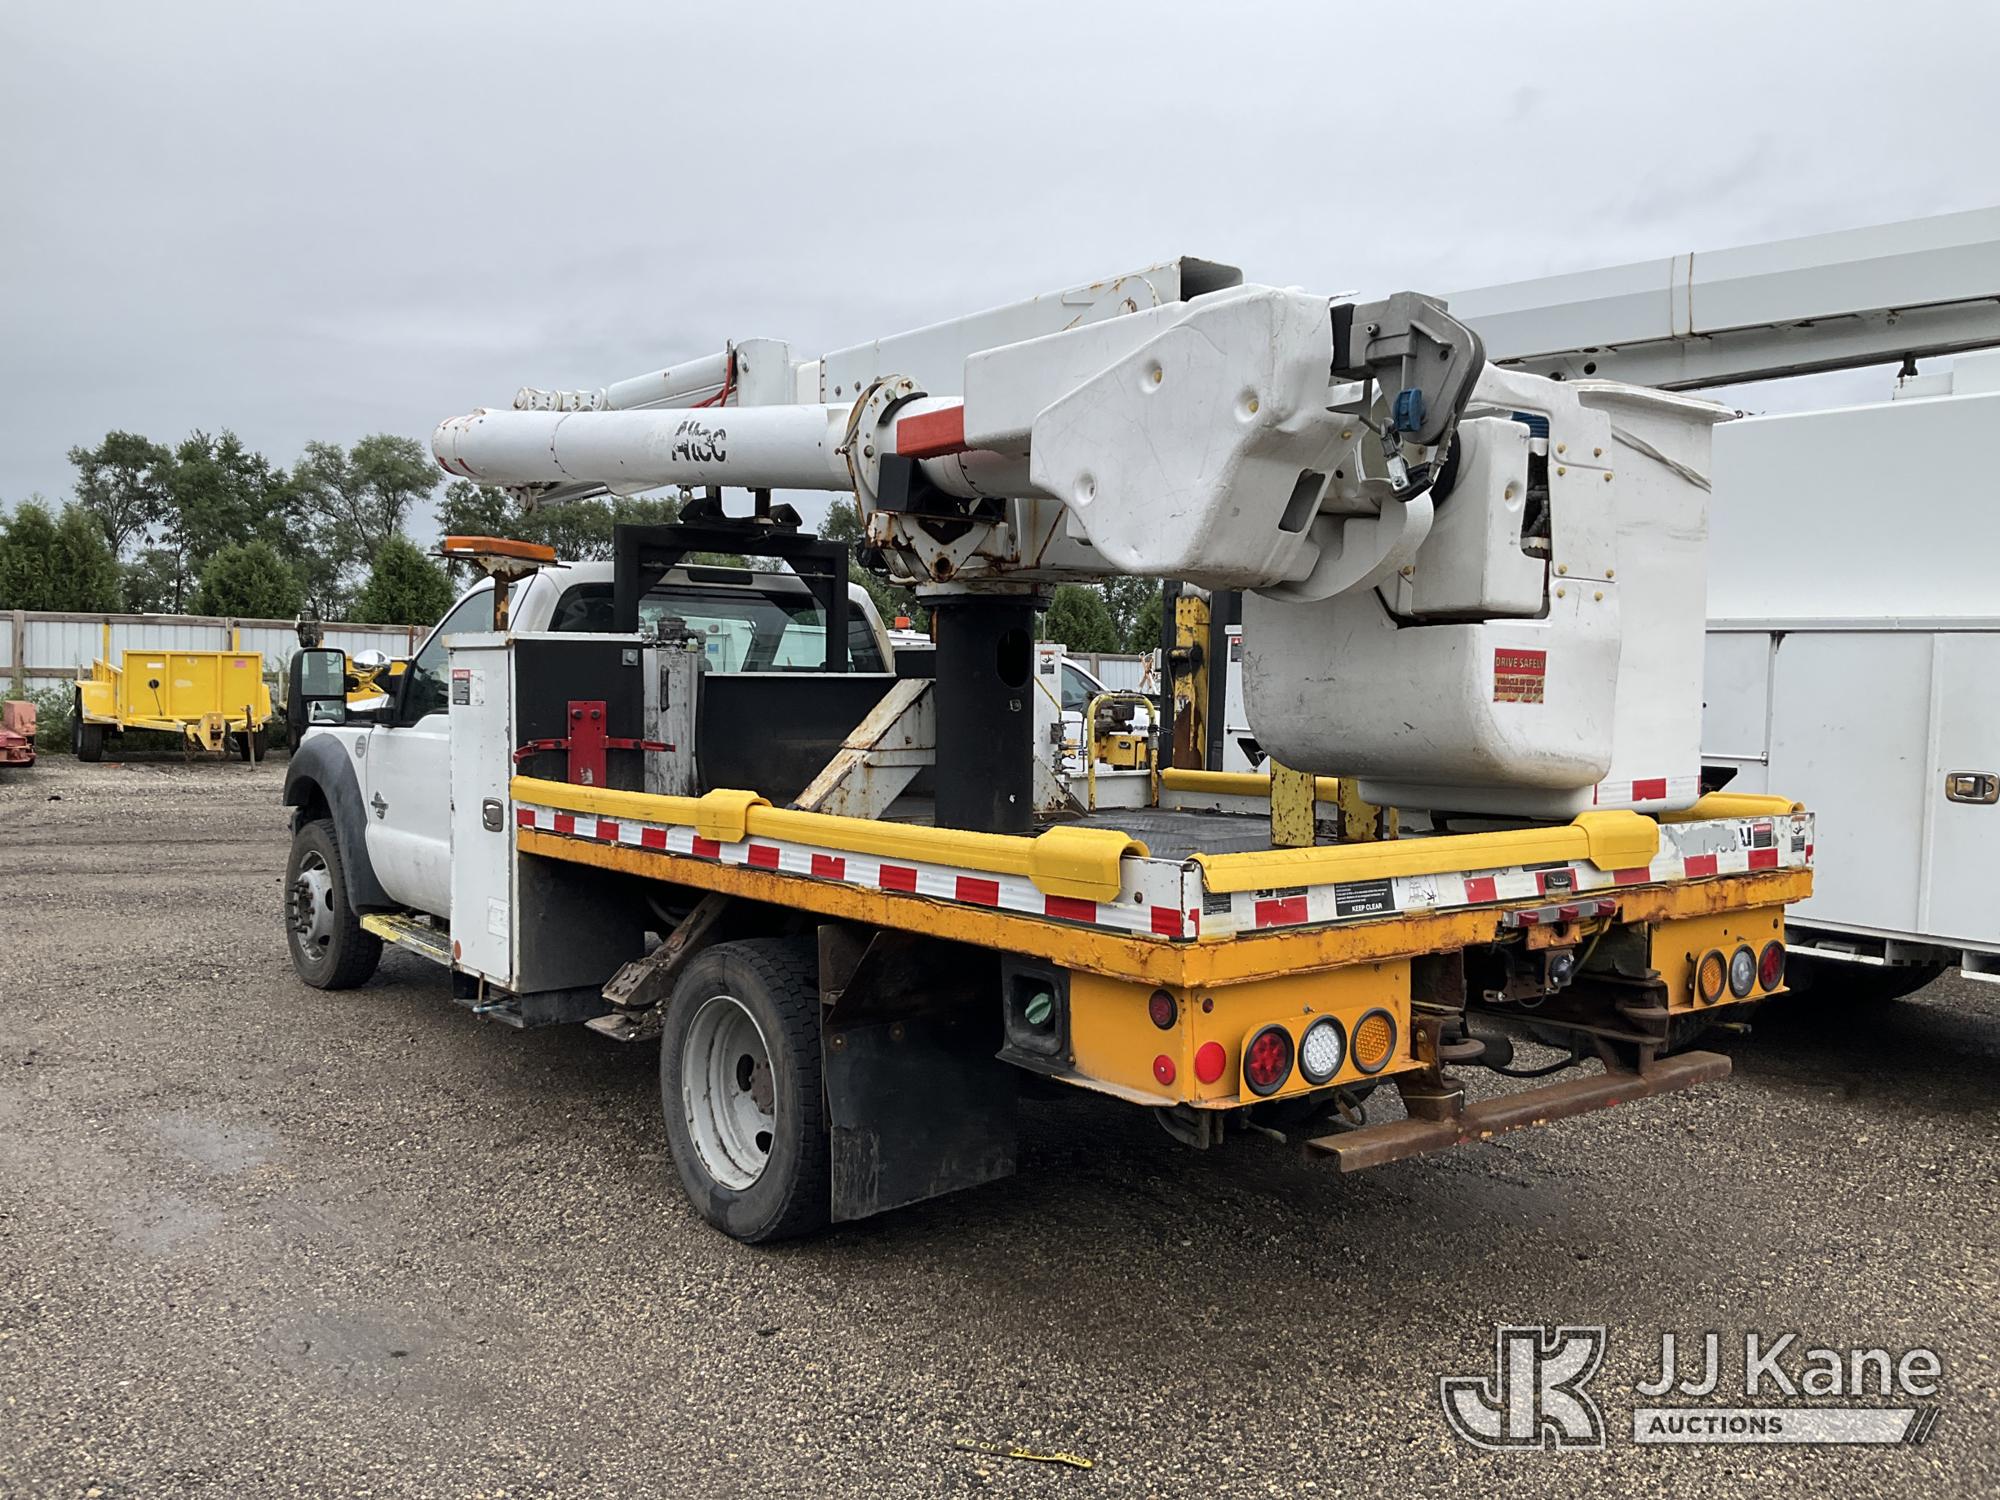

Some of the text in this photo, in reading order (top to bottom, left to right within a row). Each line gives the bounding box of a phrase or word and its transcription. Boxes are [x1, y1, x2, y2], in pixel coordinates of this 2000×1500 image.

[1496, 657, 1544, 669] DRIVE SAFELY
[1352, 903, 1382, 912] KEEP CLEAR
